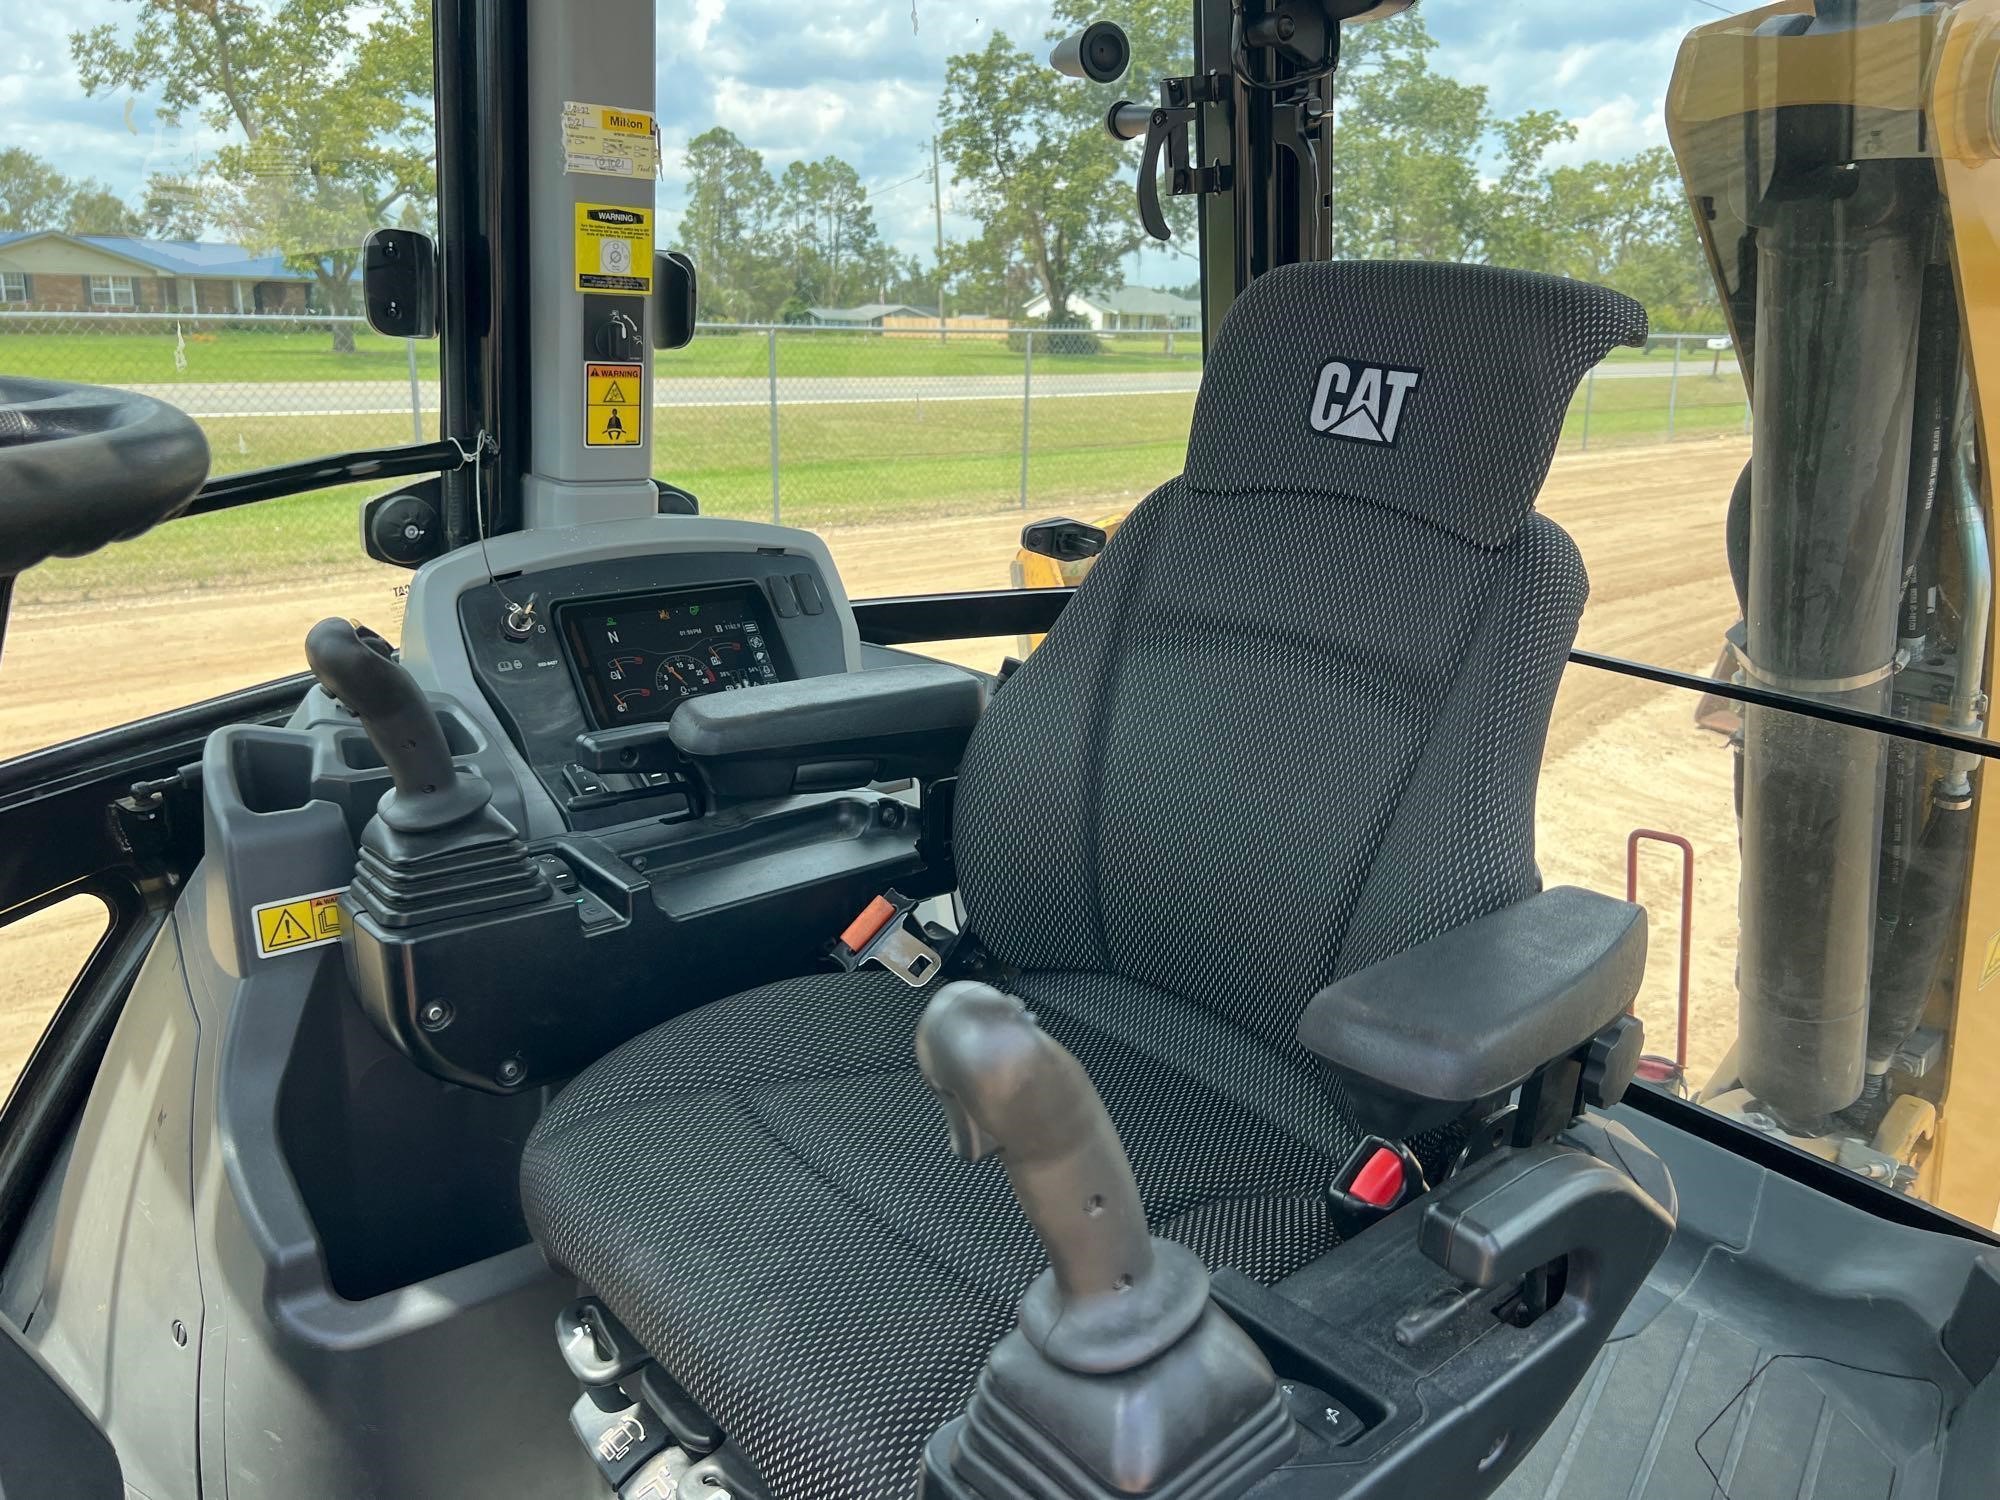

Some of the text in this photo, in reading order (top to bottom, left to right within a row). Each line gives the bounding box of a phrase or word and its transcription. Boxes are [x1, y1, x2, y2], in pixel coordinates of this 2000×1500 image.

[598, 212, 634, 222] WARNING
[601, 370, 639, 378] WARNING
[1310, 361, 1419, 443] CAT
[607, 631, 620, 645] N
